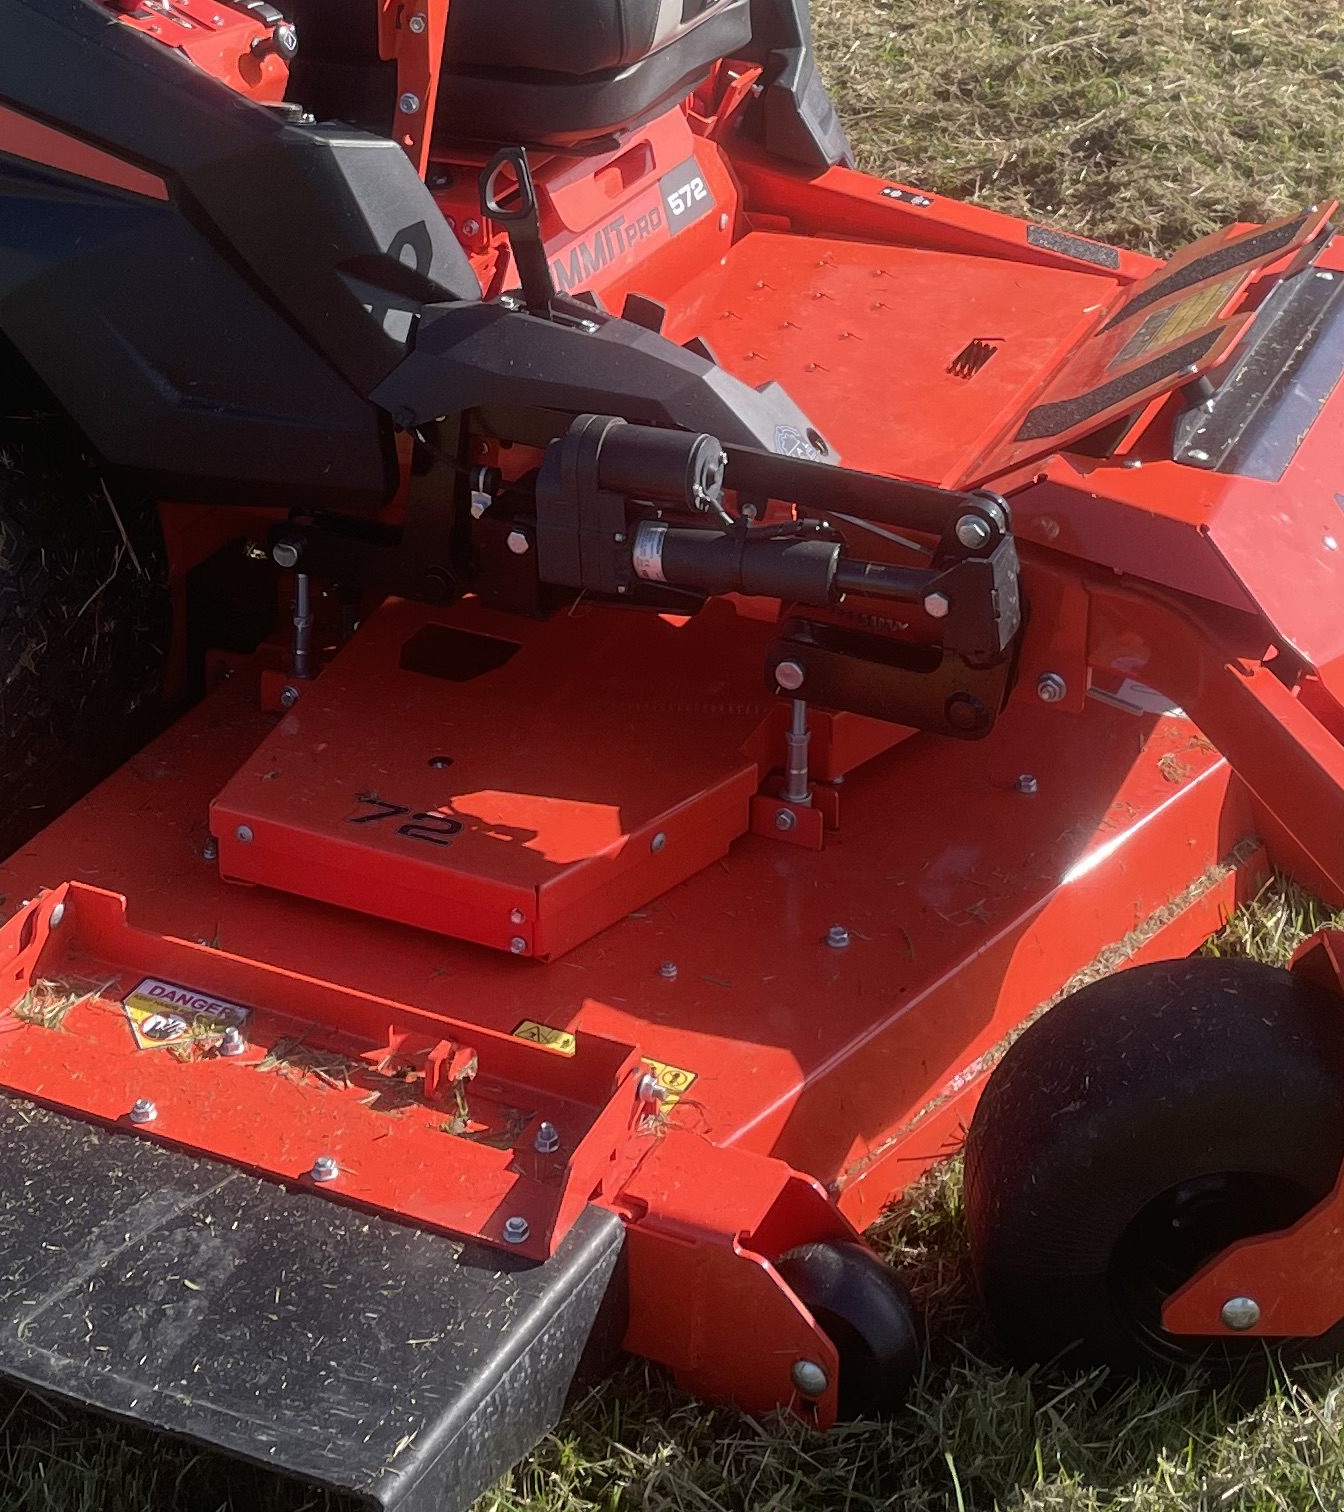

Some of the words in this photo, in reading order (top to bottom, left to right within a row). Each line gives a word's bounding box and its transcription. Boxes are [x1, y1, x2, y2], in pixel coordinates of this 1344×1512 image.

[551, 215, 626, 290] MMIT
[667, 177, 708, 216] 572
[349, 796, 464, 846] 72
